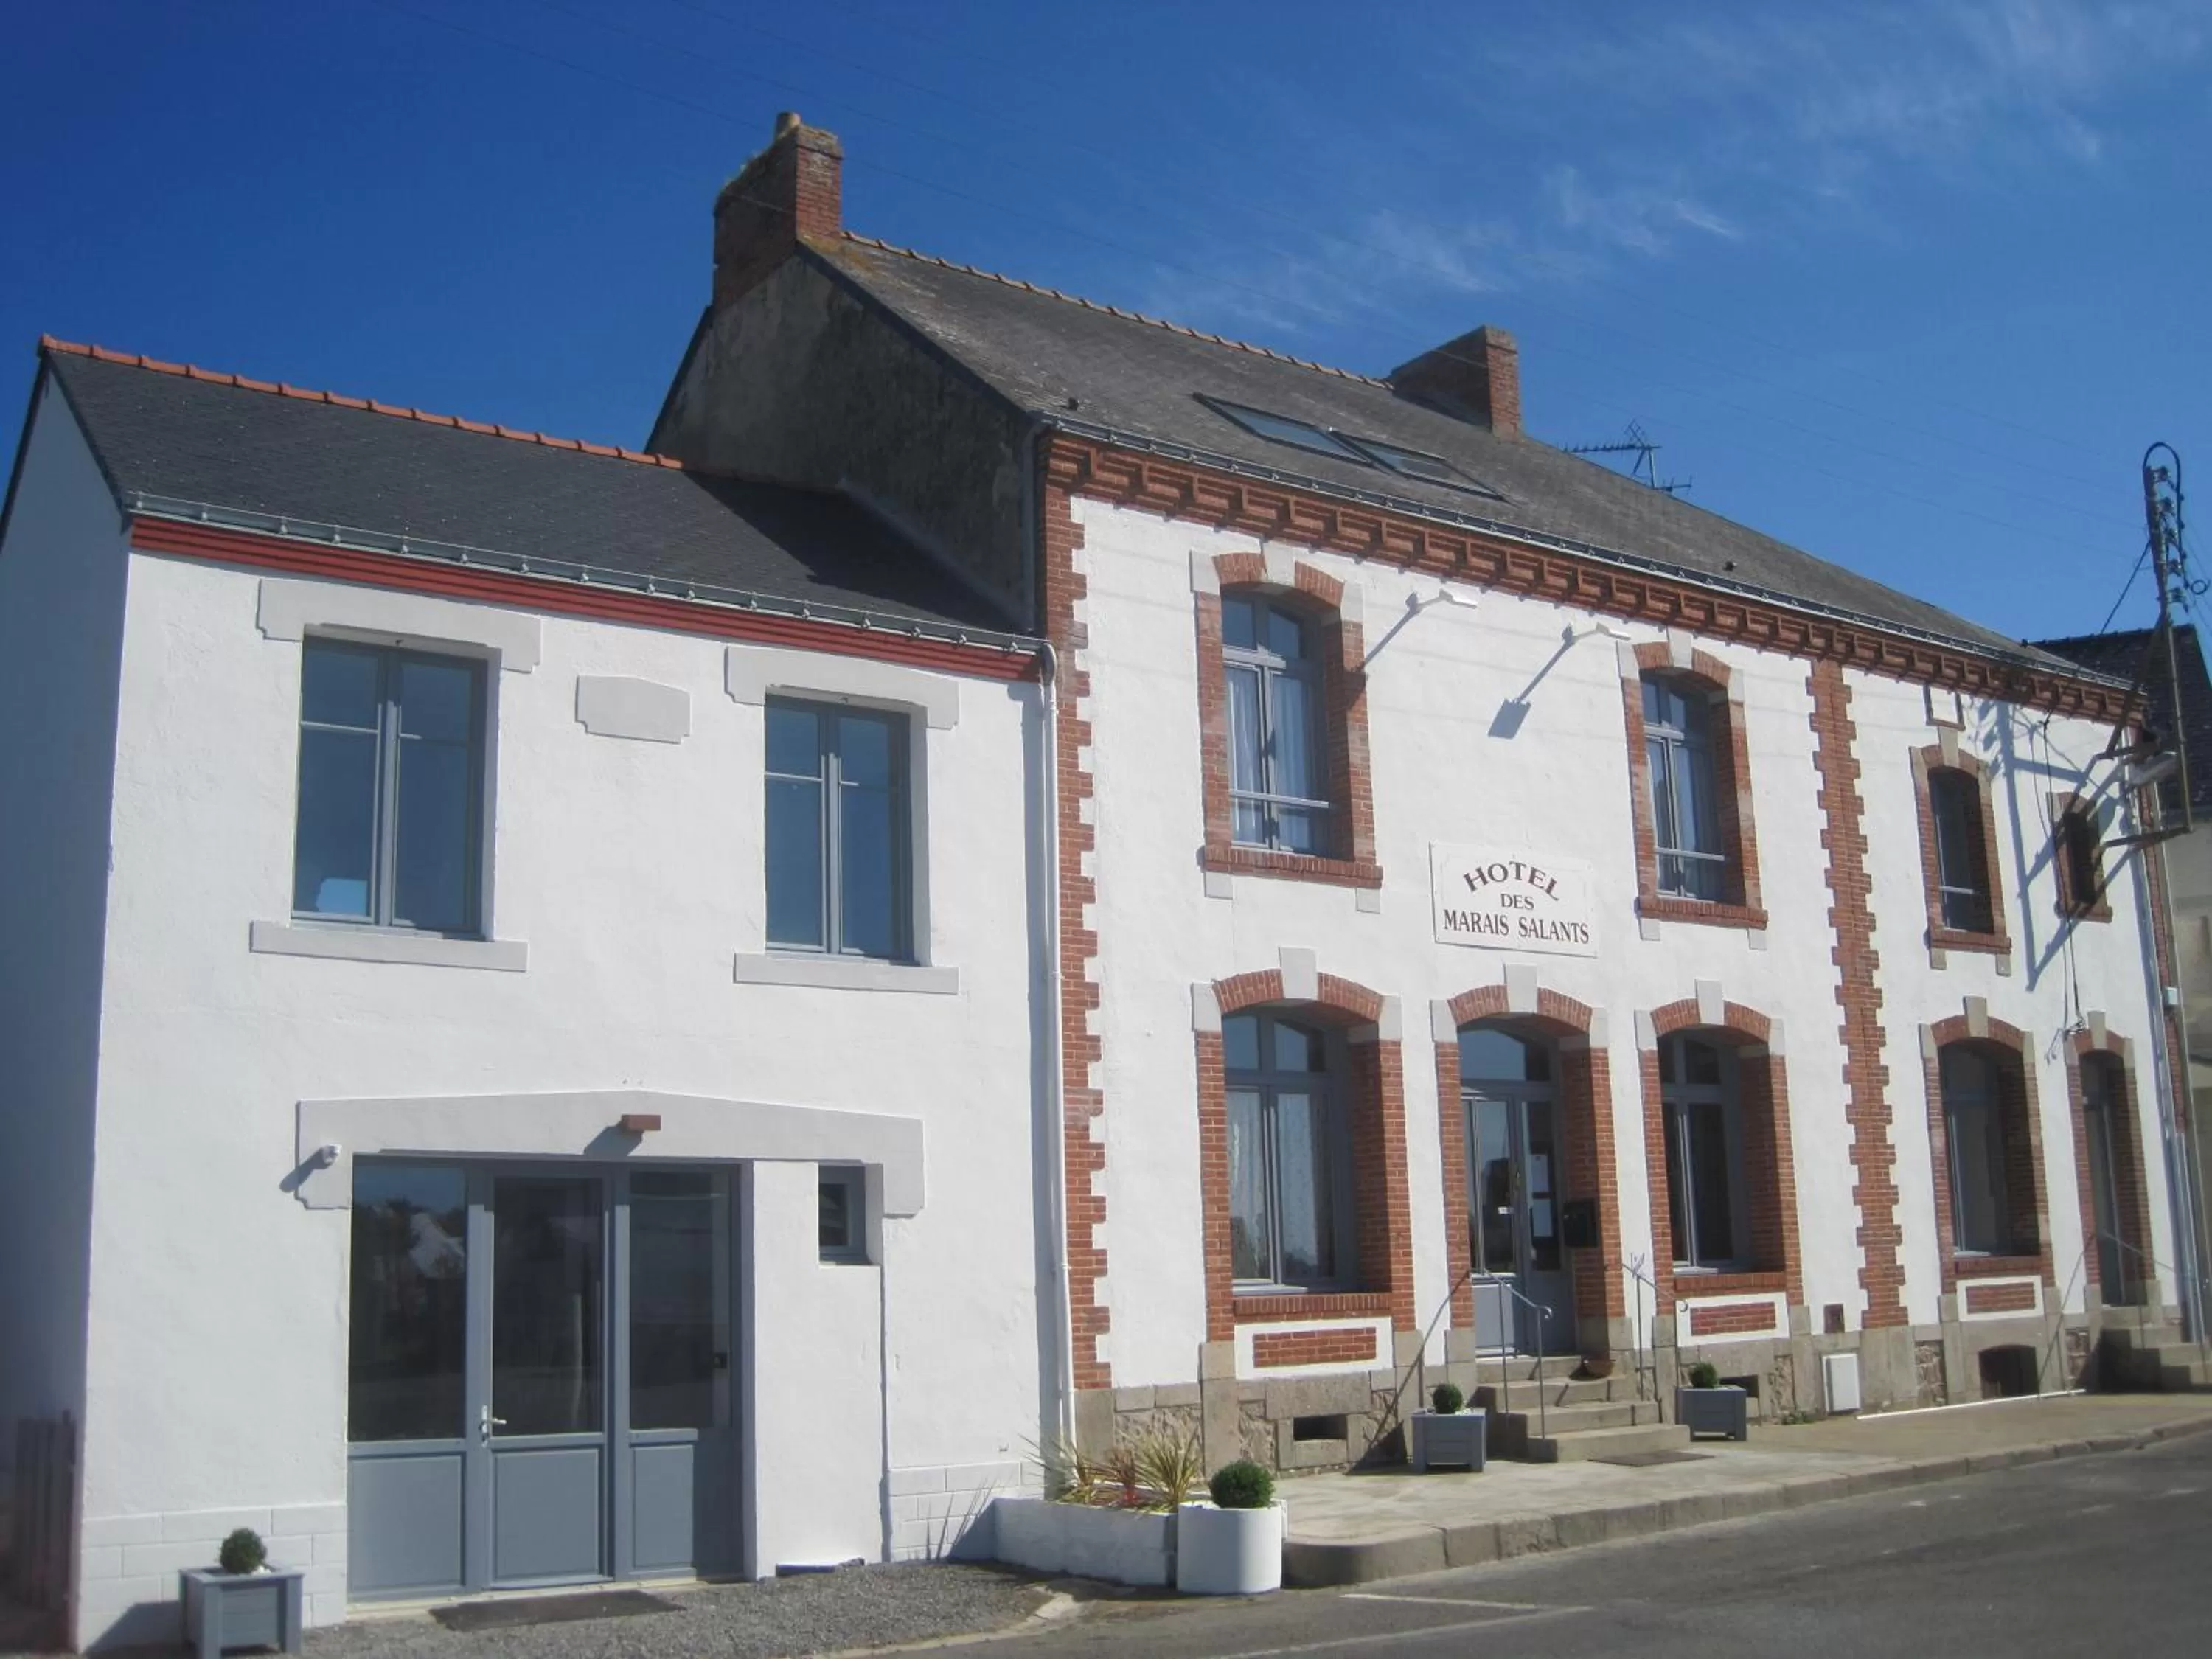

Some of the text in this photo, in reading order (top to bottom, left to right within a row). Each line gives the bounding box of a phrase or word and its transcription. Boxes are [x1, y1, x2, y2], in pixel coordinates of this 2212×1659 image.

[1463, 860, 1559, 901] HOTEL
[1500, 893, 1534, 911] DES
[1443, 909, 1590, 944] MARAIS SALANTS
